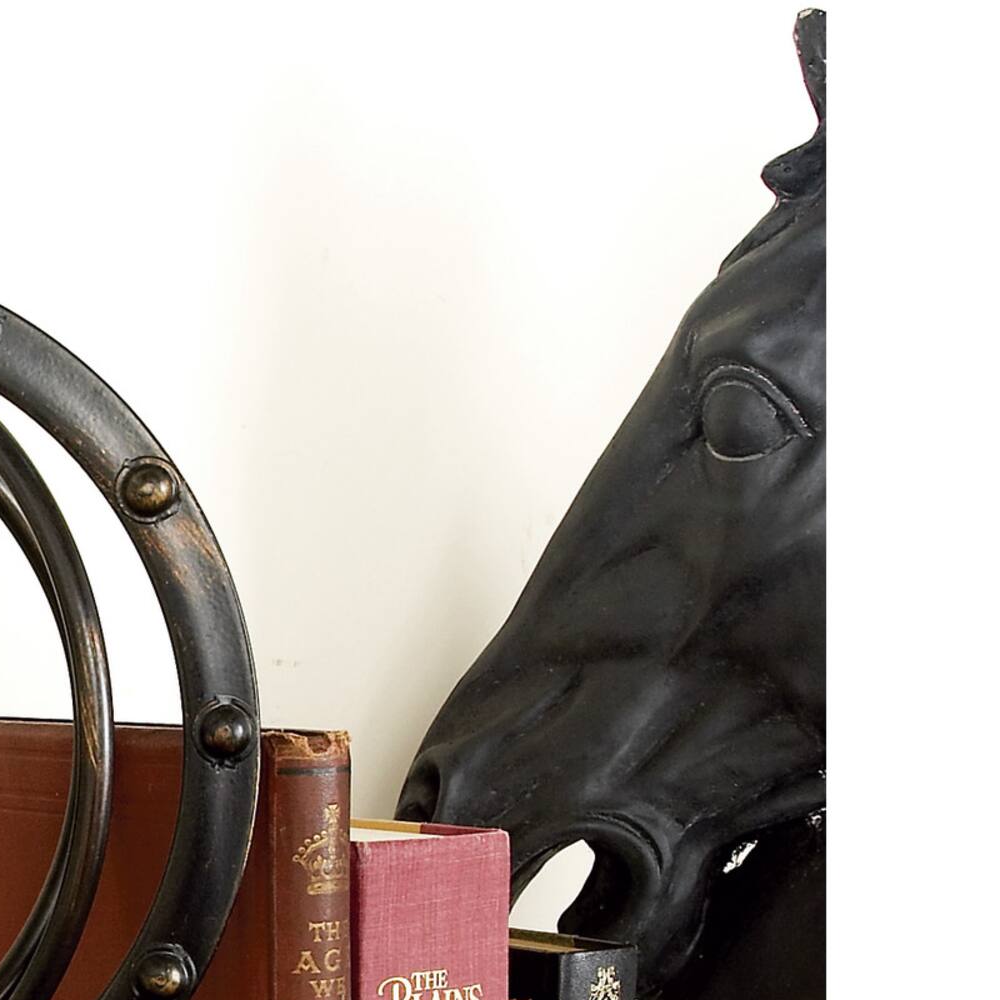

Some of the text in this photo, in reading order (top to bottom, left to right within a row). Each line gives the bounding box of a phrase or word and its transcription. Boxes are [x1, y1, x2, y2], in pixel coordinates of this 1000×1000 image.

[308, 920, 348, 942] TH
[291, 948, 341, 974] AG
[411, 969, 449, 991] THE
